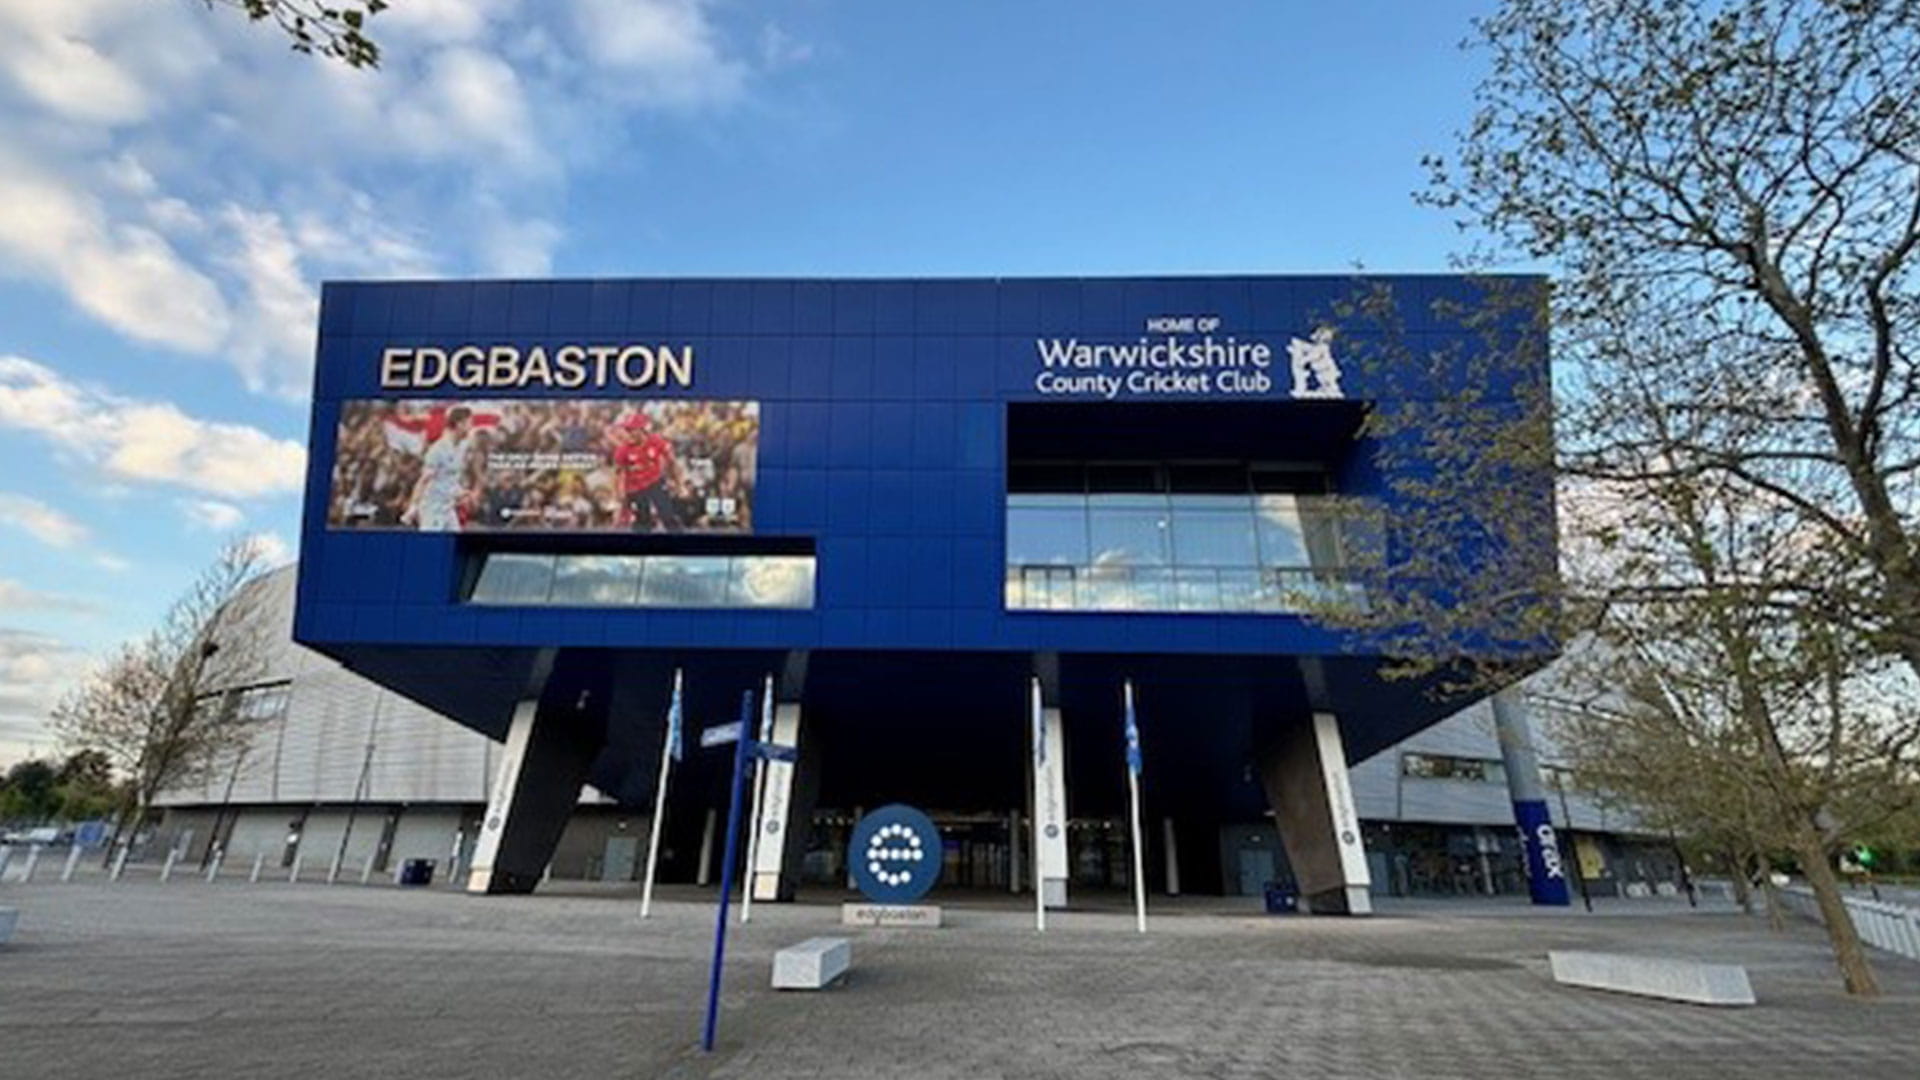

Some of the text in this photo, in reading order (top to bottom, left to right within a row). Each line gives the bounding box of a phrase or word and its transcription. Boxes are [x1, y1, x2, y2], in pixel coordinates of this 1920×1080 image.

[1147, 317, 1220, 332] HOME OF
[380, 345, 693, 387] EDGBASTON
[1037, 337, 1272, 368] Warwickshire
[1036, 370, 1272, 399] County Cricket Club
